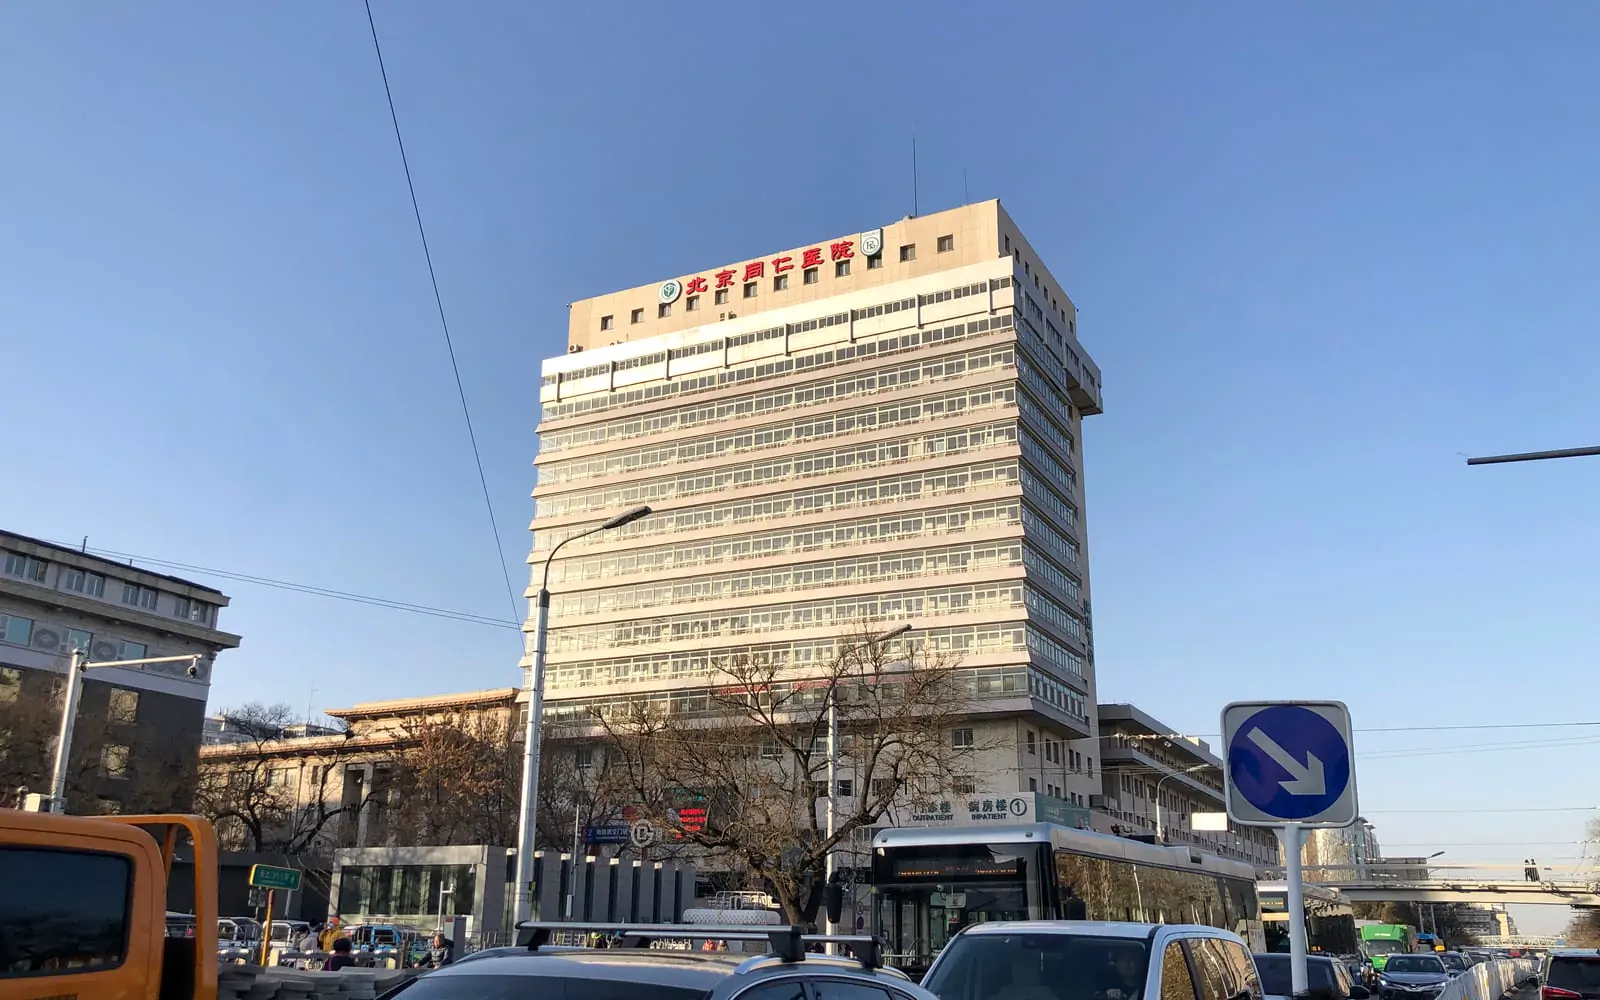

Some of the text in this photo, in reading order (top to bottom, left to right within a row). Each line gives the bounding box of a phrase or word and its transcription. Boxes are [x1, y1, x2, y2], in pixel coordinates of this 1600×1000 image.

[686, 240, 855, 296] 北京同仁医院
[968, 798, 1008, 813] 病房楼
[912, 812, 1007, 822] OUTPATIENT INPATIENT
